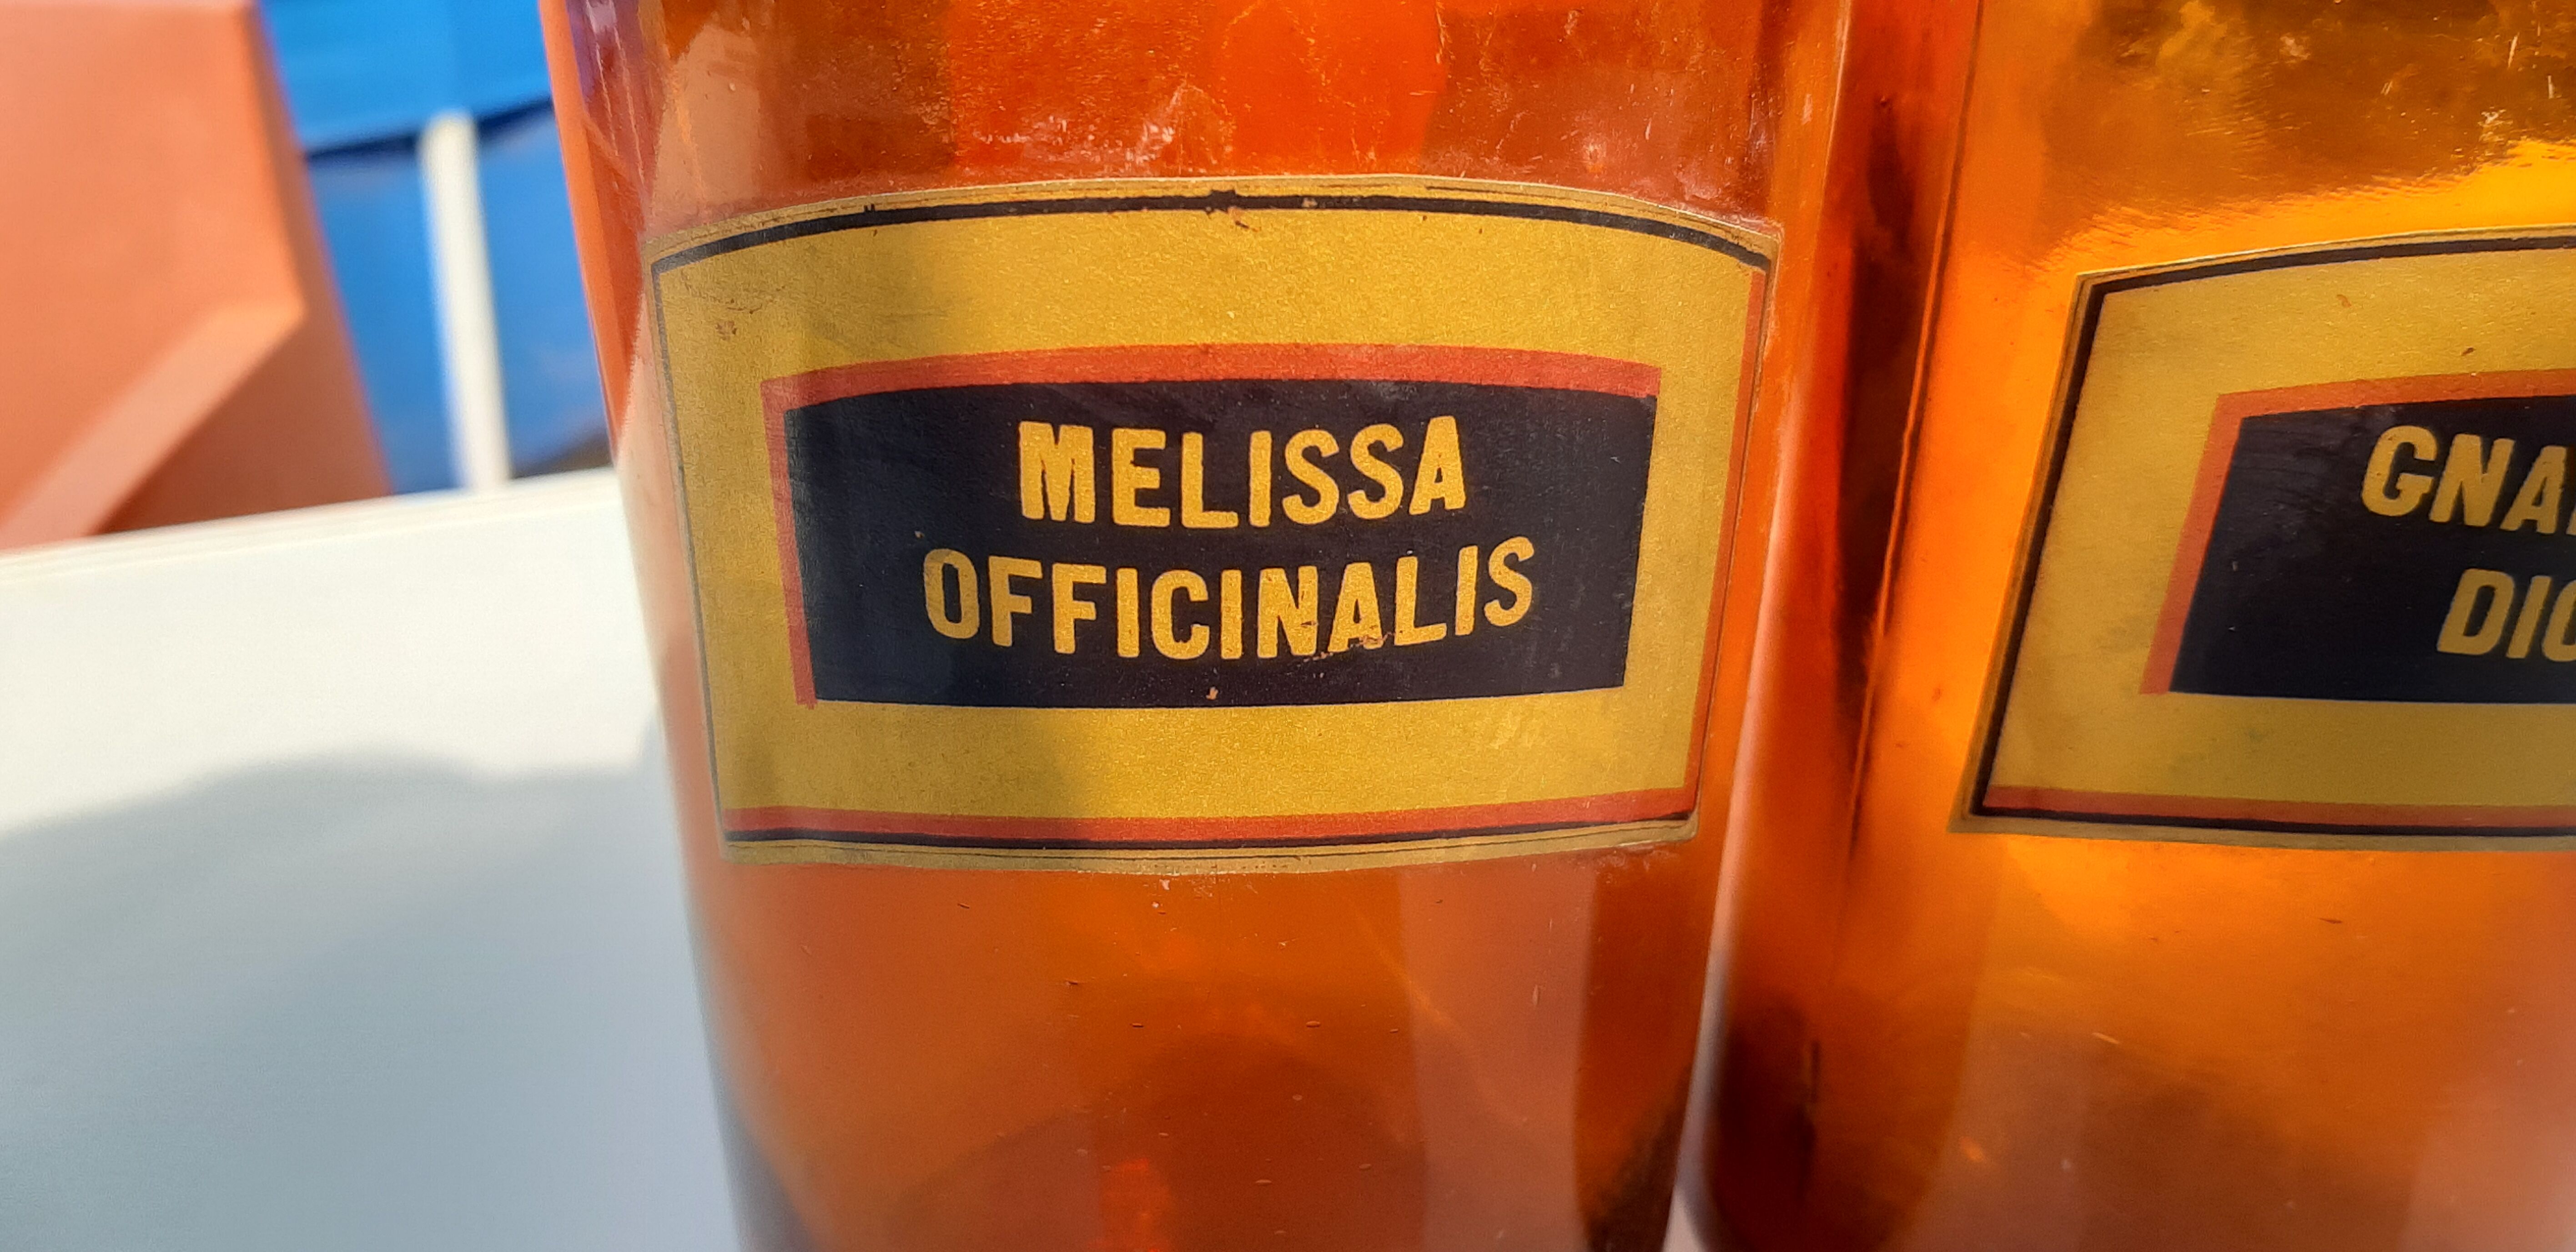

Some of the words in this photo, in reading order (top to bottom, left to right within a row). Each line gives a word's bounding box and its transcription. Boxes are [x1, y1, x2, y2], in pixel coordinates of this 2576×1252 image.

[1018, 415, 1466, 529] MELISSA
[2360, 425, 2576, 535] GNA
[923, 536, 1535, 660] OFFICINALIS
